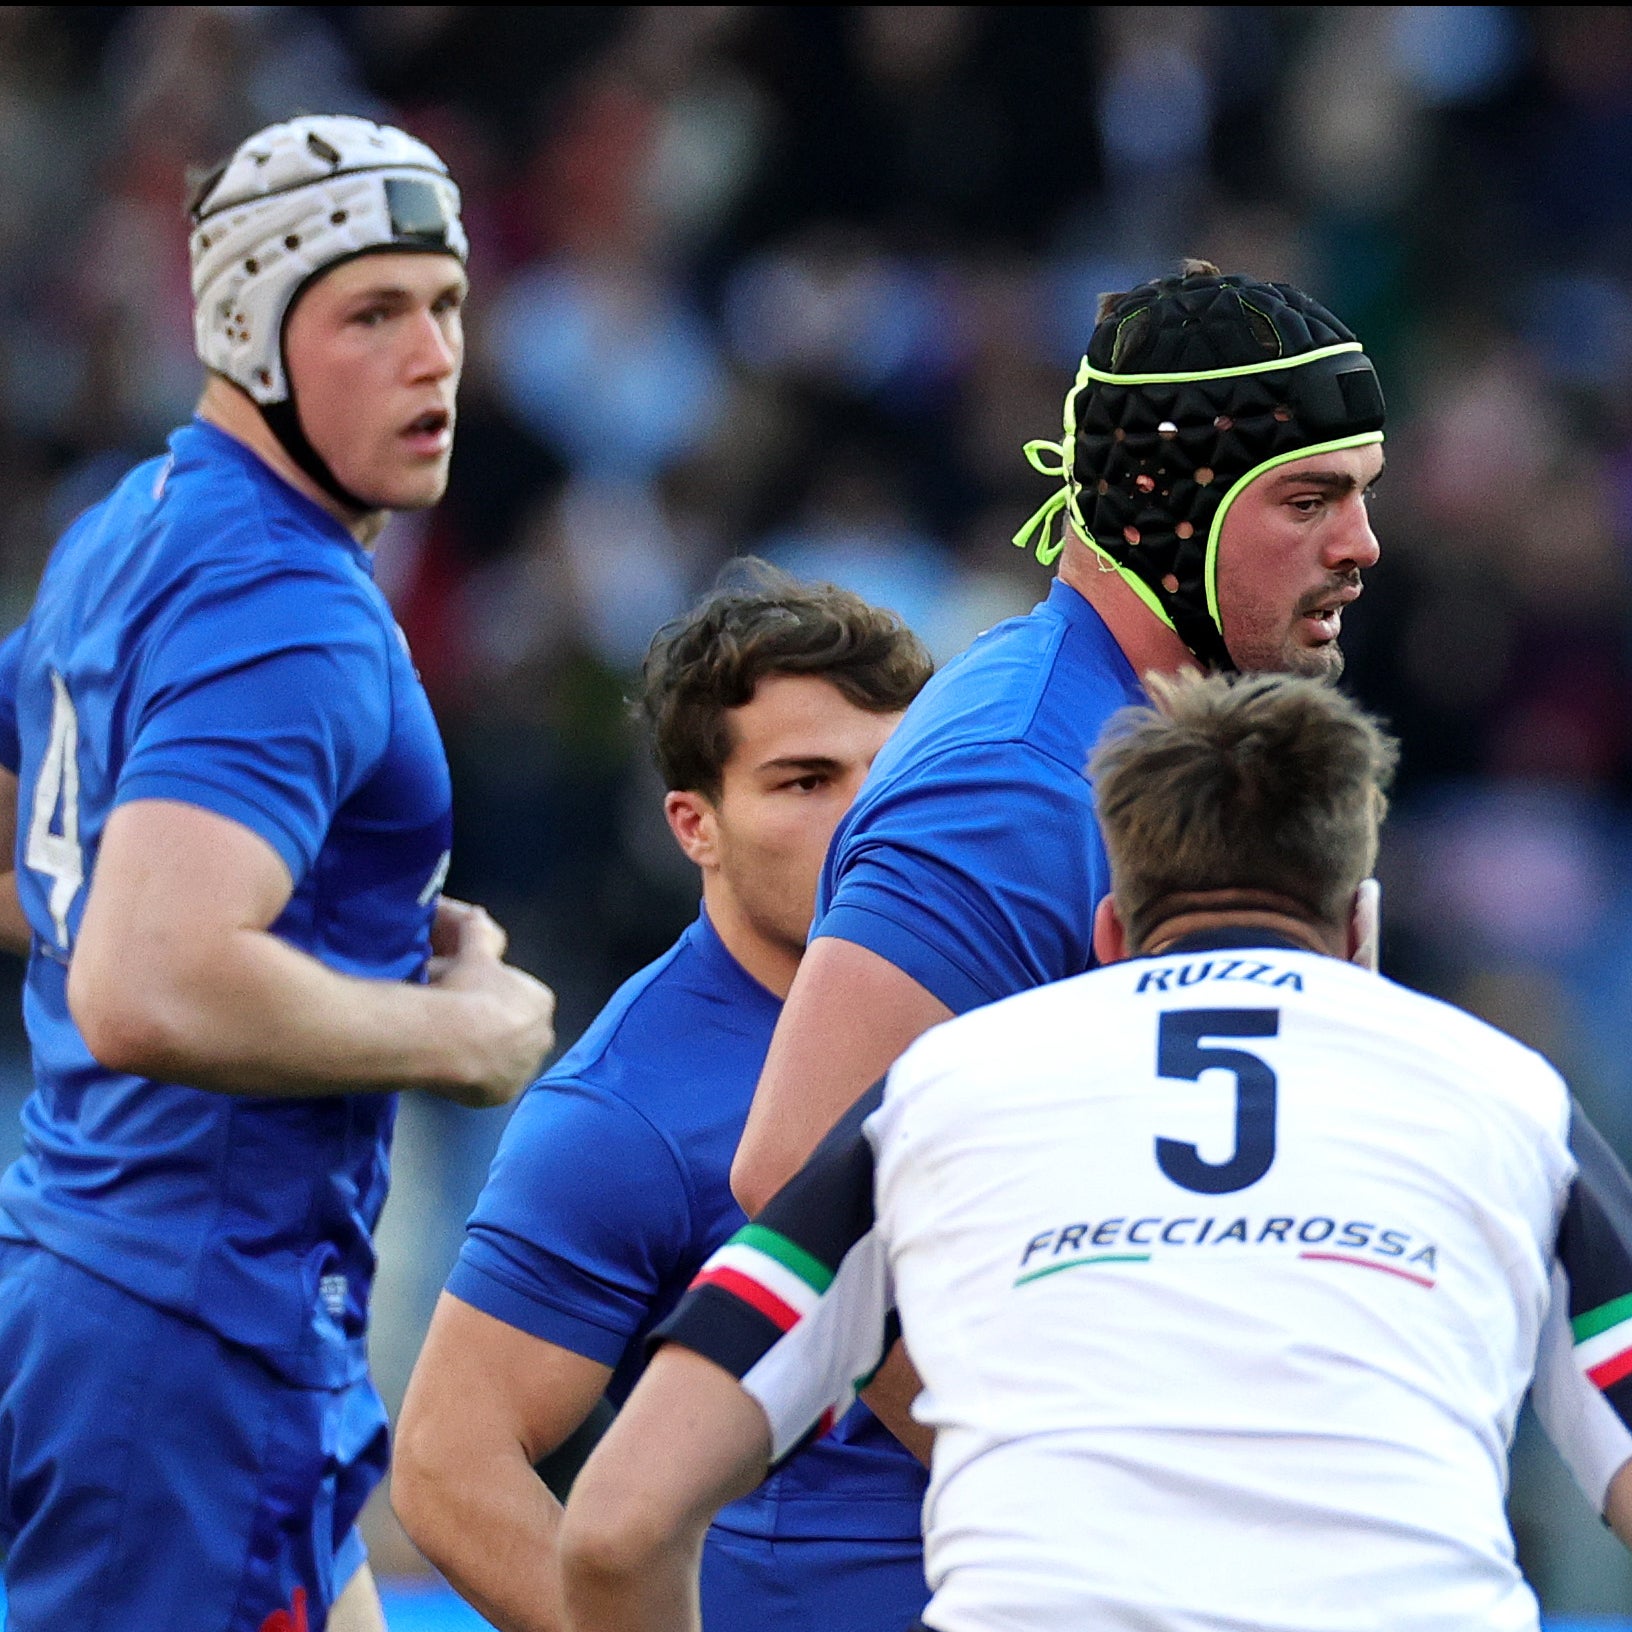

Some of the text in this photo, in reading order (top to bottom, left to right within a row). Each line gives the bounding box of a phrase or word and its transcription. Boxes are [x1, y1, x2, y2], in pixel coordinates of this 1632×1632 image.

[24, 668, 84, 948] 4
[1136, 959, 1304, 993] RUZZA
[1154, 1007, 1280, 1195] 5
[1020, 1216, 1438, 1269] FRECCIAROSSA
